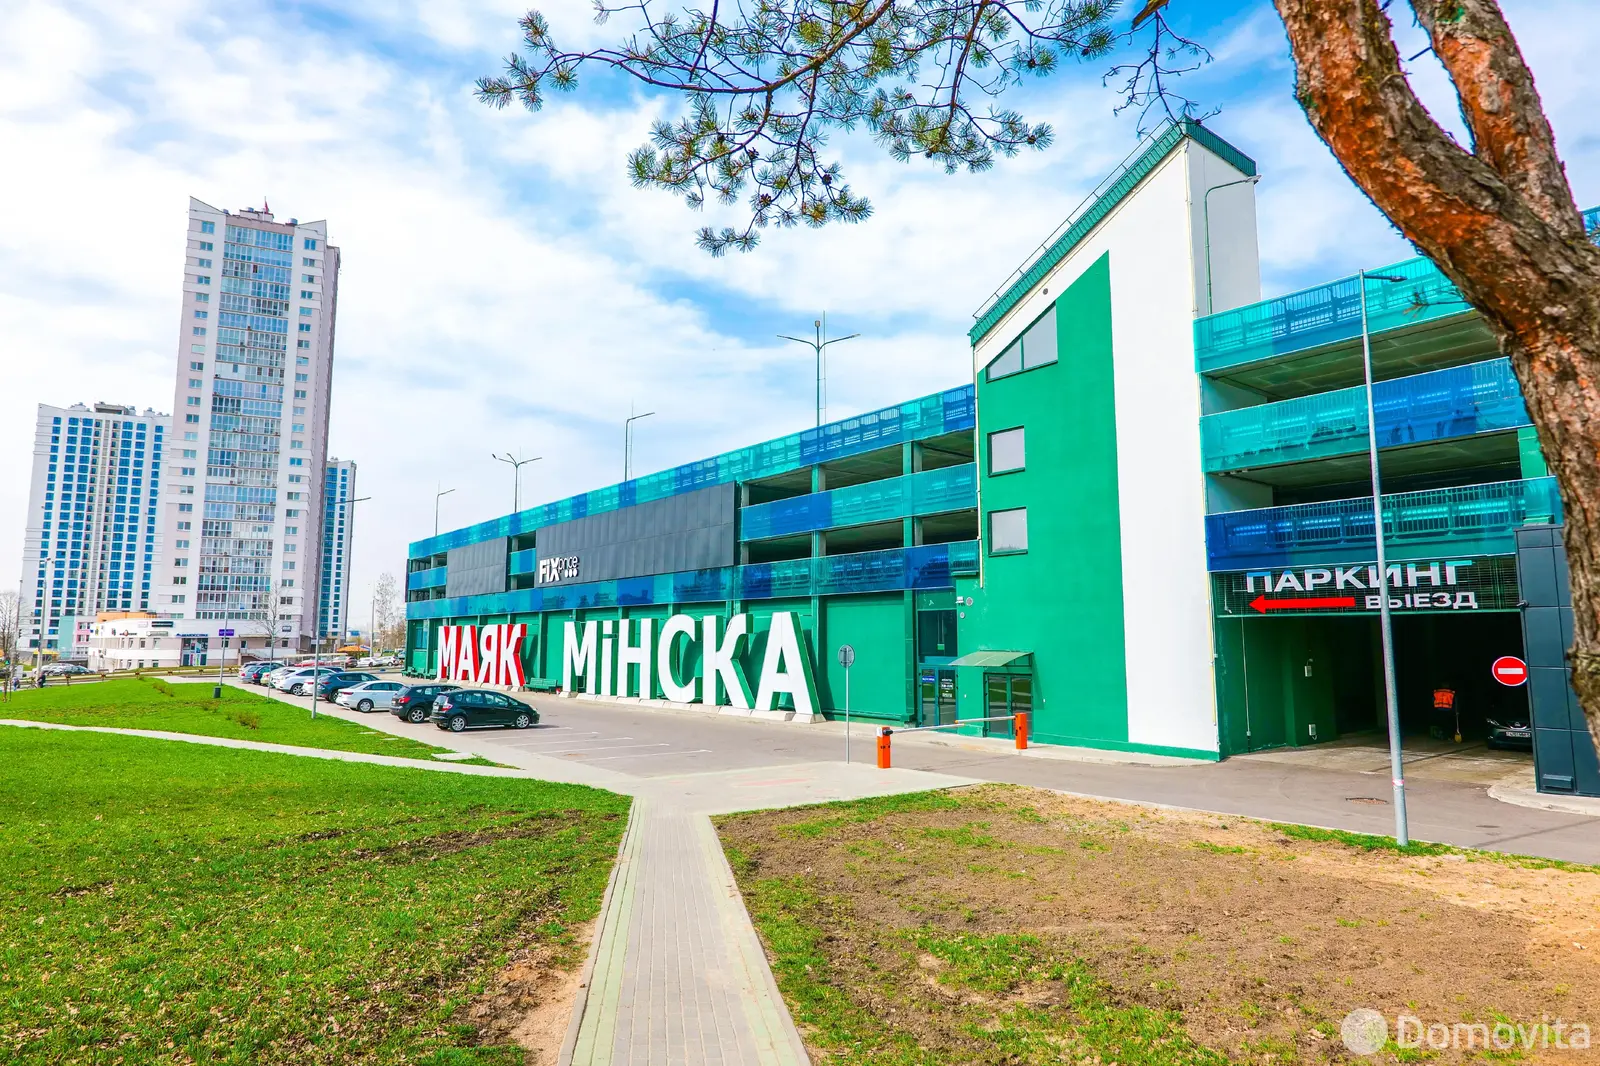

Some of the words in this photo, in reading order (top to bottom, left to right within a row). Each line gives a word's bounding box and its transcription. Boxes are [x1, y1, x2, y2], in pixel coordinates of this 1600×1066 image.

[1246, 560, 1473, 593] ПАРКИНГ
[1365, 591, 1479, 609] ВЫЕЗД
[437, 623, 528, 687] МАЯК
